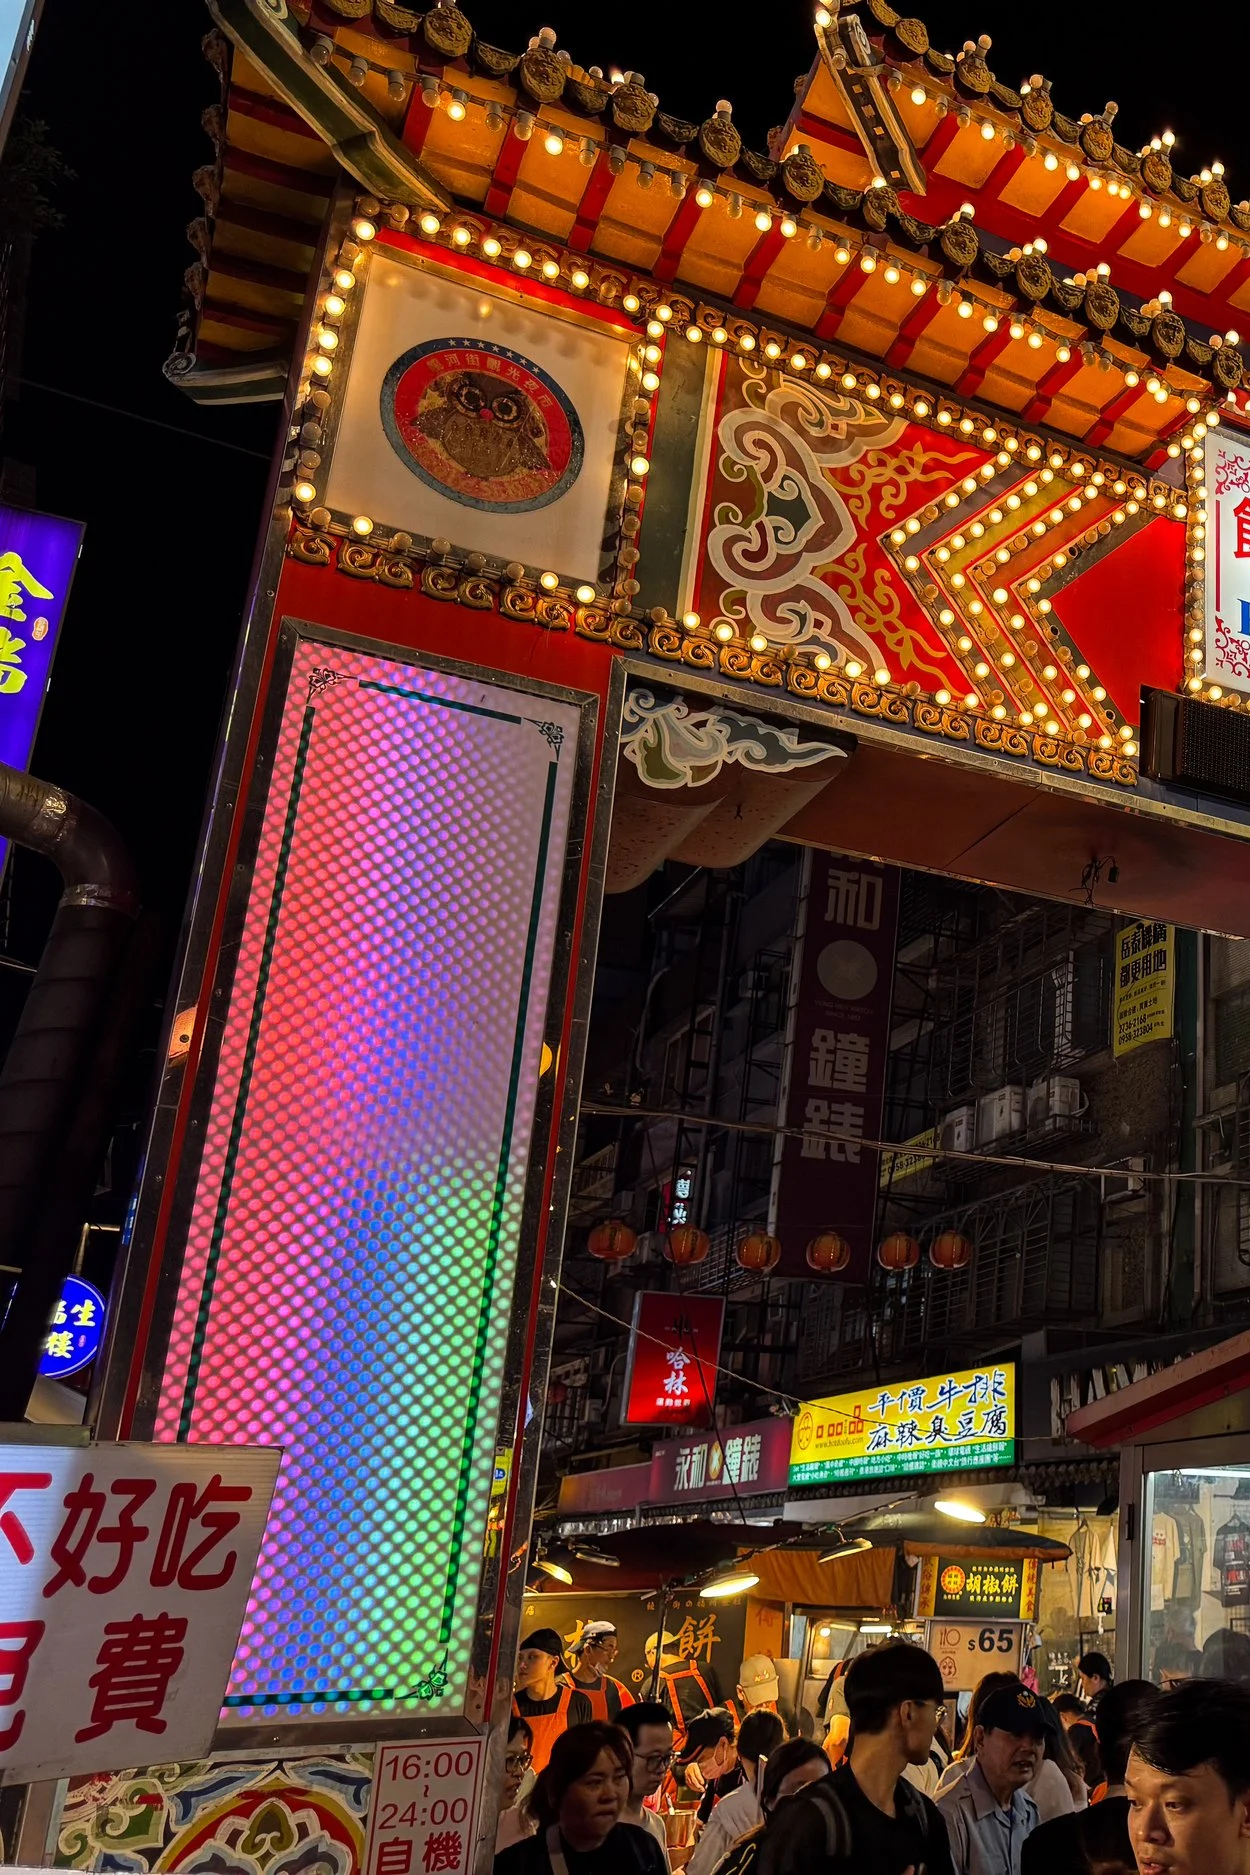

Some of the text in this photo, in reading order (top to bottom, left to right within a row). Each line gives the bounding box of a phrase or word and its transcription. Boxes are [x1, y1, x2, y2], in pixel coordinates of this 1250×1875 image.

[801, 851, 884, 1164] 和 鐘錶
[663, 1346, 691, 1396] 哈林
[868, 1368, 1008, 1418] 平價牛排
[866, 1403, 1008, 1452] 麻辣臭豆腐
[674, 1442, 709, 1492] 永和
[722, 1434, 762, 1485] 鐘錶
[966, 1572, 1019, 1595] 胡椒餅
[967, 1627, 1014, 1653] $65
[385, 1750, 474, 1781] 16:00
[378, 1798, 468, 1830] 24:00
